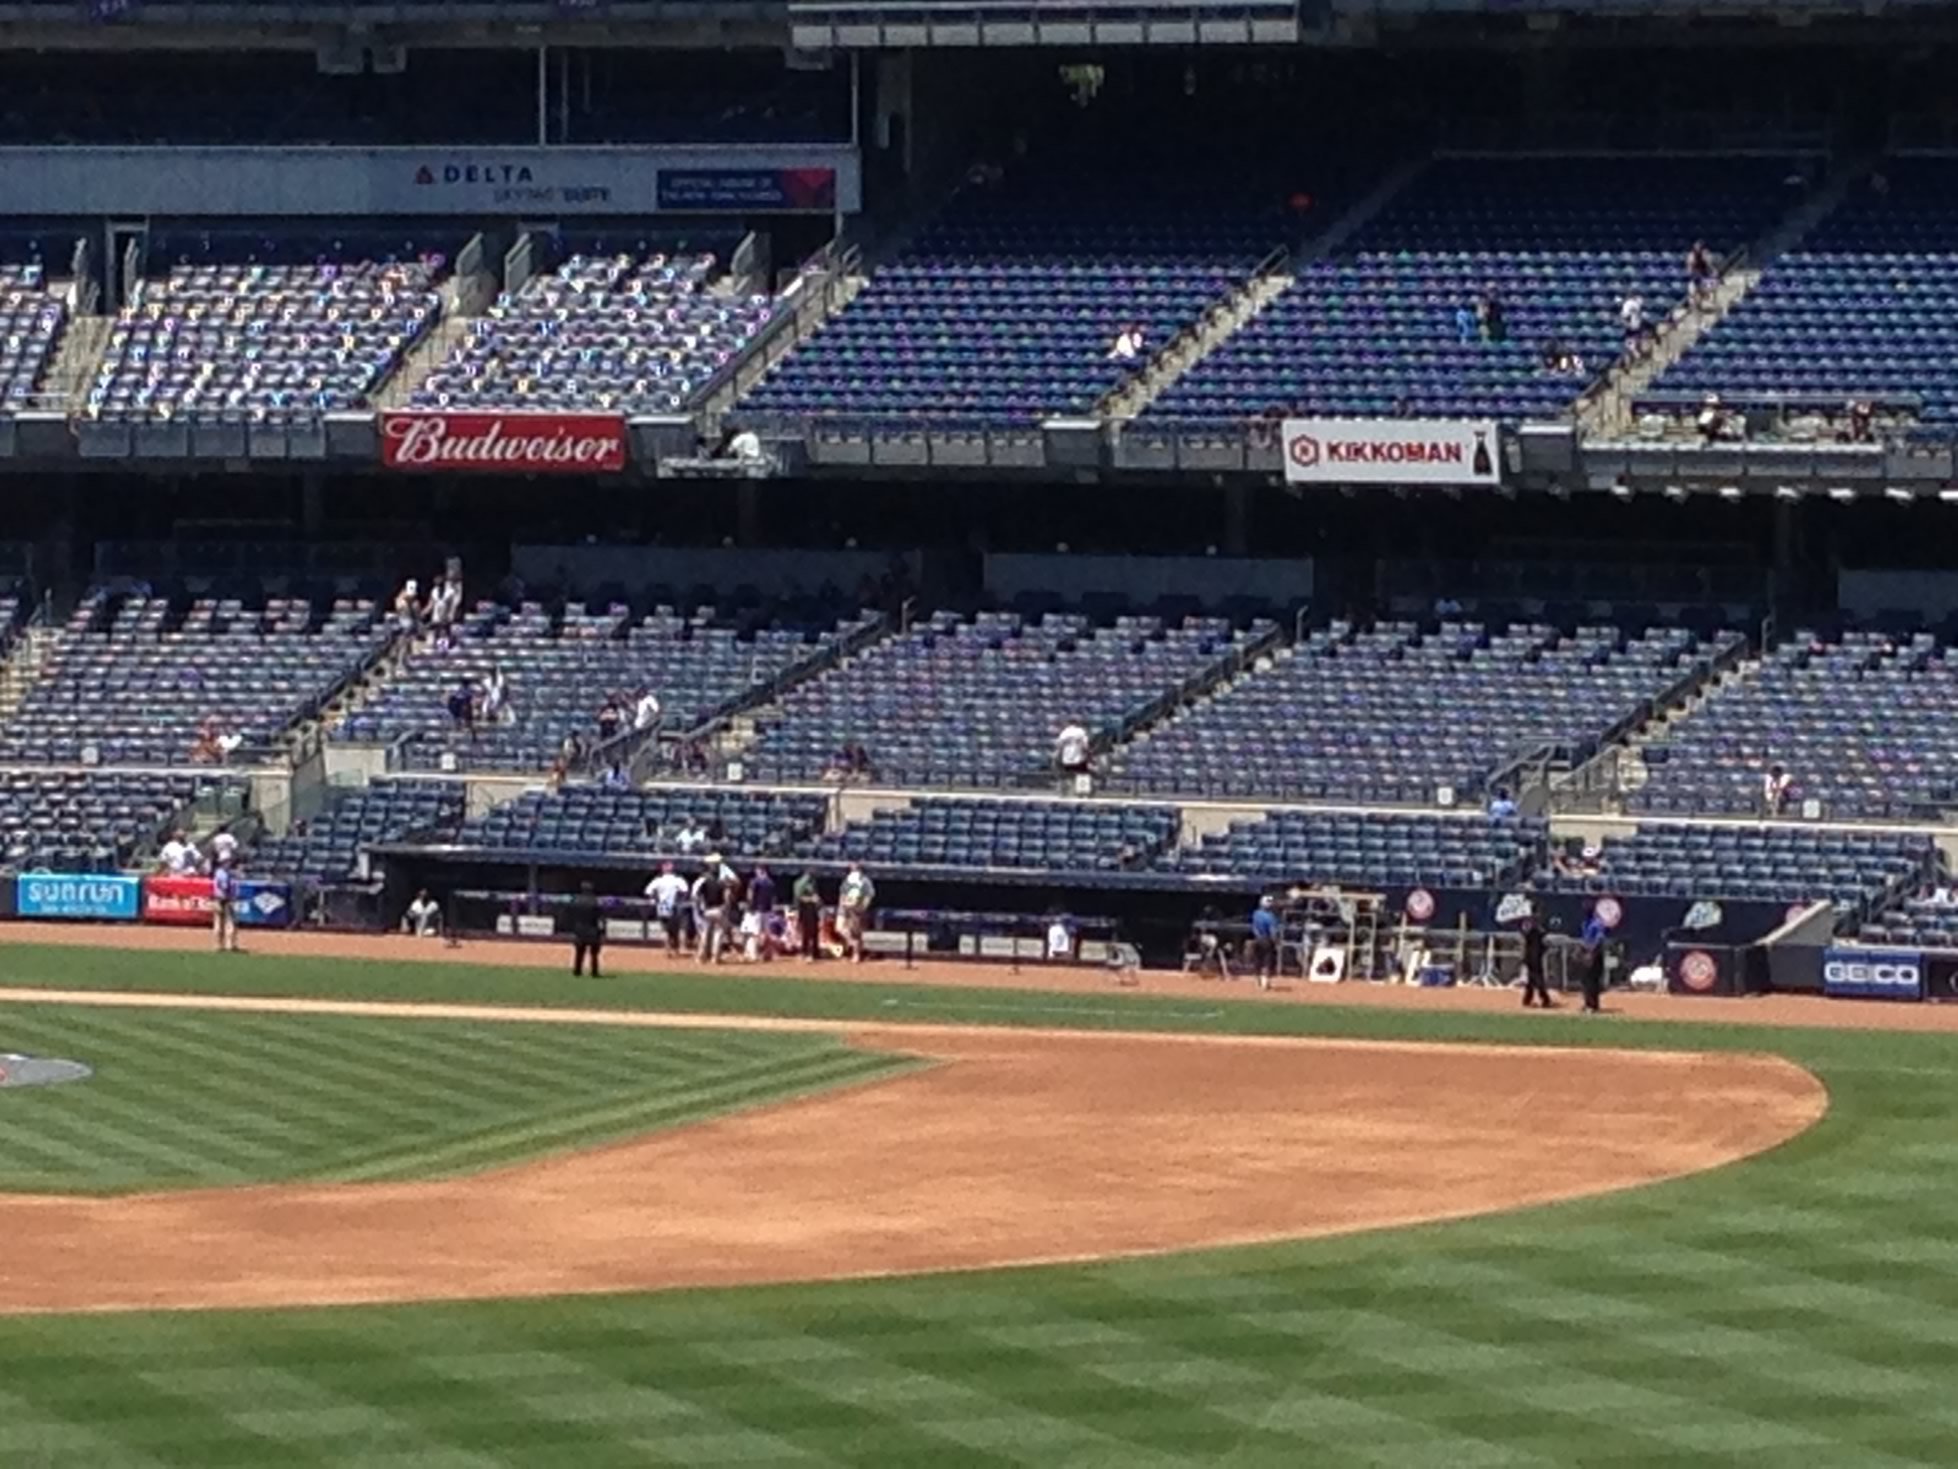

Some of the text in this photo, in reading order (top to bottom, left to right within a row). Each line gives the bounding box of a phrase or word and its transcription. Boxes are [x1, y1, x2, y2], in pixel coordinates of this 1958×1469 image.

[443, 165, 533, 183] DELTA
[385, 416, 620, 463] Budweiser
[1325, 441, 1463, 462] KIKKOMAN
[28, 882, 124, 905] sunrun
[1823, 960, 1920, 985] GEICO
